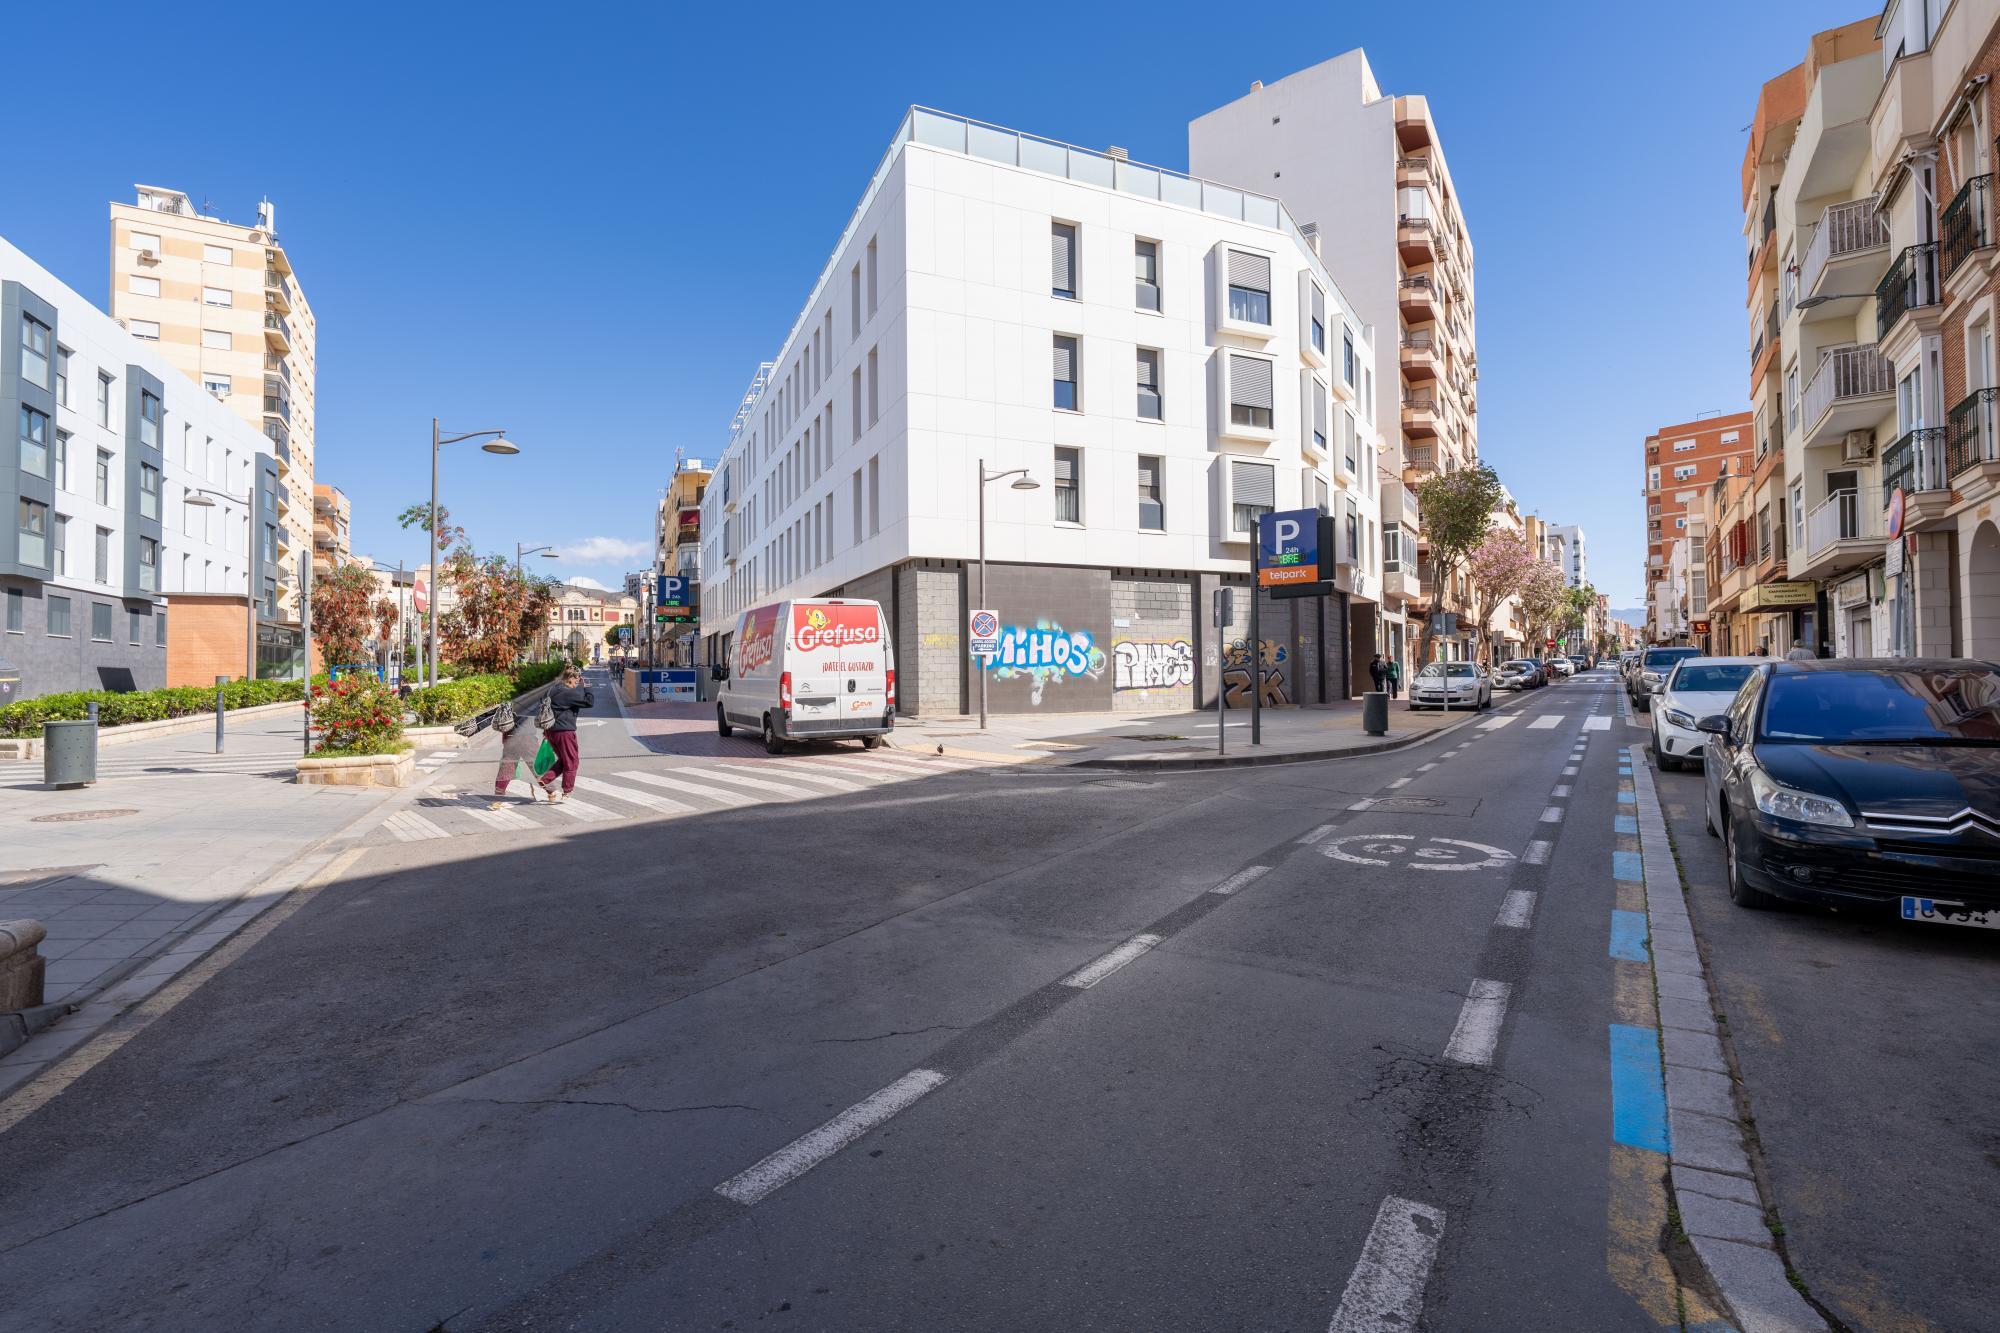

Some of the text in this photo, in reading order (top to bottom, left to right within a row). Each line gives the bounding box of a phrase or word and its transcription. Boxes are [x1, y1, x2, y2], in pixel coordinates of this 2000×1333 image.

[1275, 519, 1300, 555] P
[1285, 546, 1299, 554] 24h
[1270, 569, 1306, 580] telpark
[665, 577, 682, 599] P
[797, 624, 877, 649] Grefusa
[740, 633, 772, 673] Grefusa
[840, 661, 847, 672] EL
[660, 671, 670, 683] P
